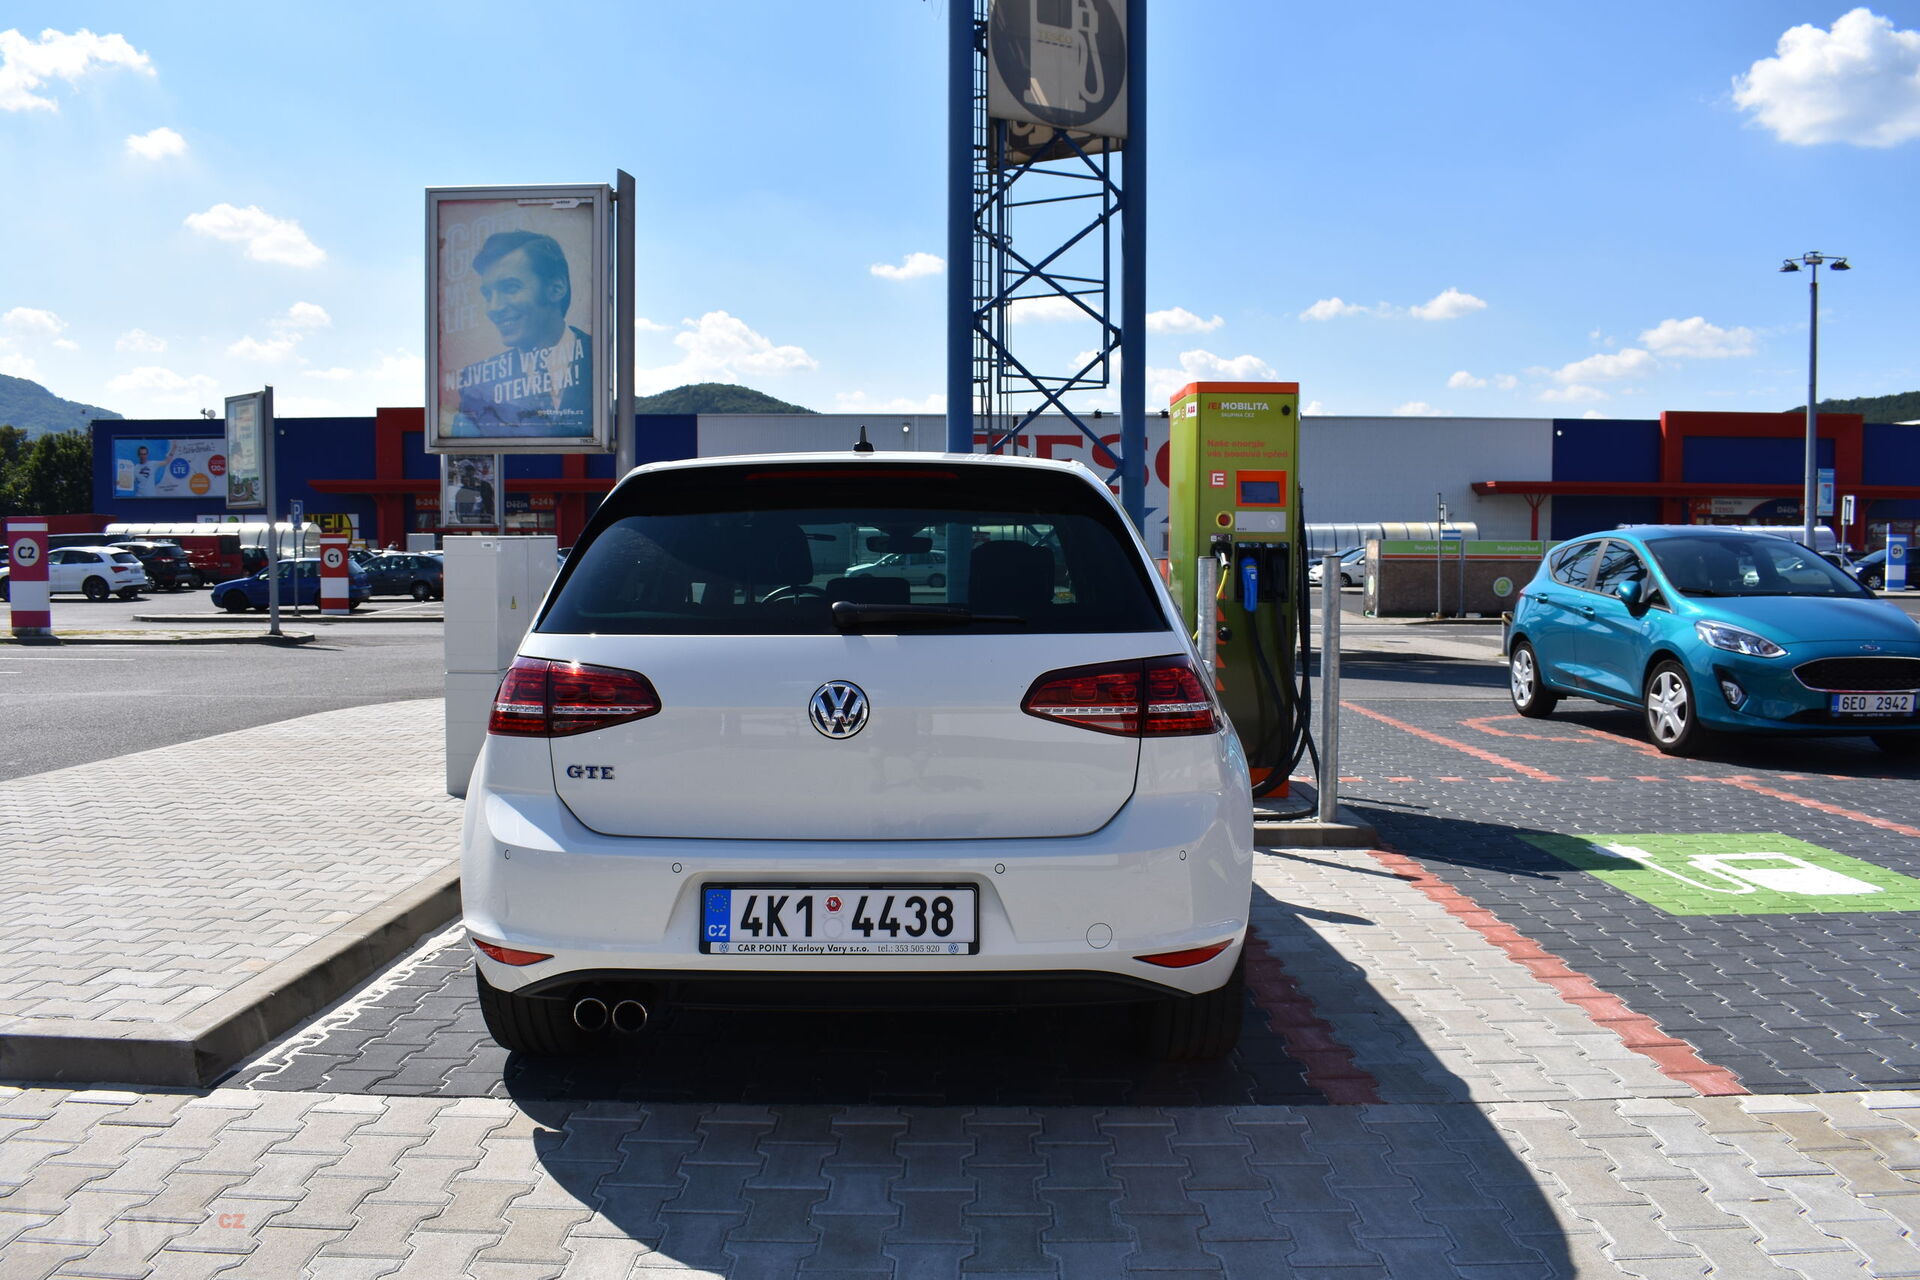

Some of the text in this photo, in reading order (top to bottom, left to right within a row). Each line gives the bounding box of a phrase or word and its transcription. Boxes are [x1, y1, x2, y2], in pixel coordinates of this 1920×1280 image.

[445, 353, 513, 391] NEJVĚTŠÍ
[293, 504, 301, 520] P
[18, 545, 36, 559] C2
[327, 553, 339, 563] C1
[1893, 547, 1902, 555] D1
[1876, 696, 1908, 711] 2942
[567, 765, 615, 780] GTE
[740, 895, 954, 937] 4K1 4438
[708, 924, 727, 937] CZ
[738, 944, 757, 953] CAR
[759, 944, 787, 953] POINT
[792, 944, 825, 955] Karlovy
[827, 944, 848, 955] Vary
[895, 945, 909, 953] 353
[910, 945, 924, 953] 505
[925, 945, 941, 953] 920
